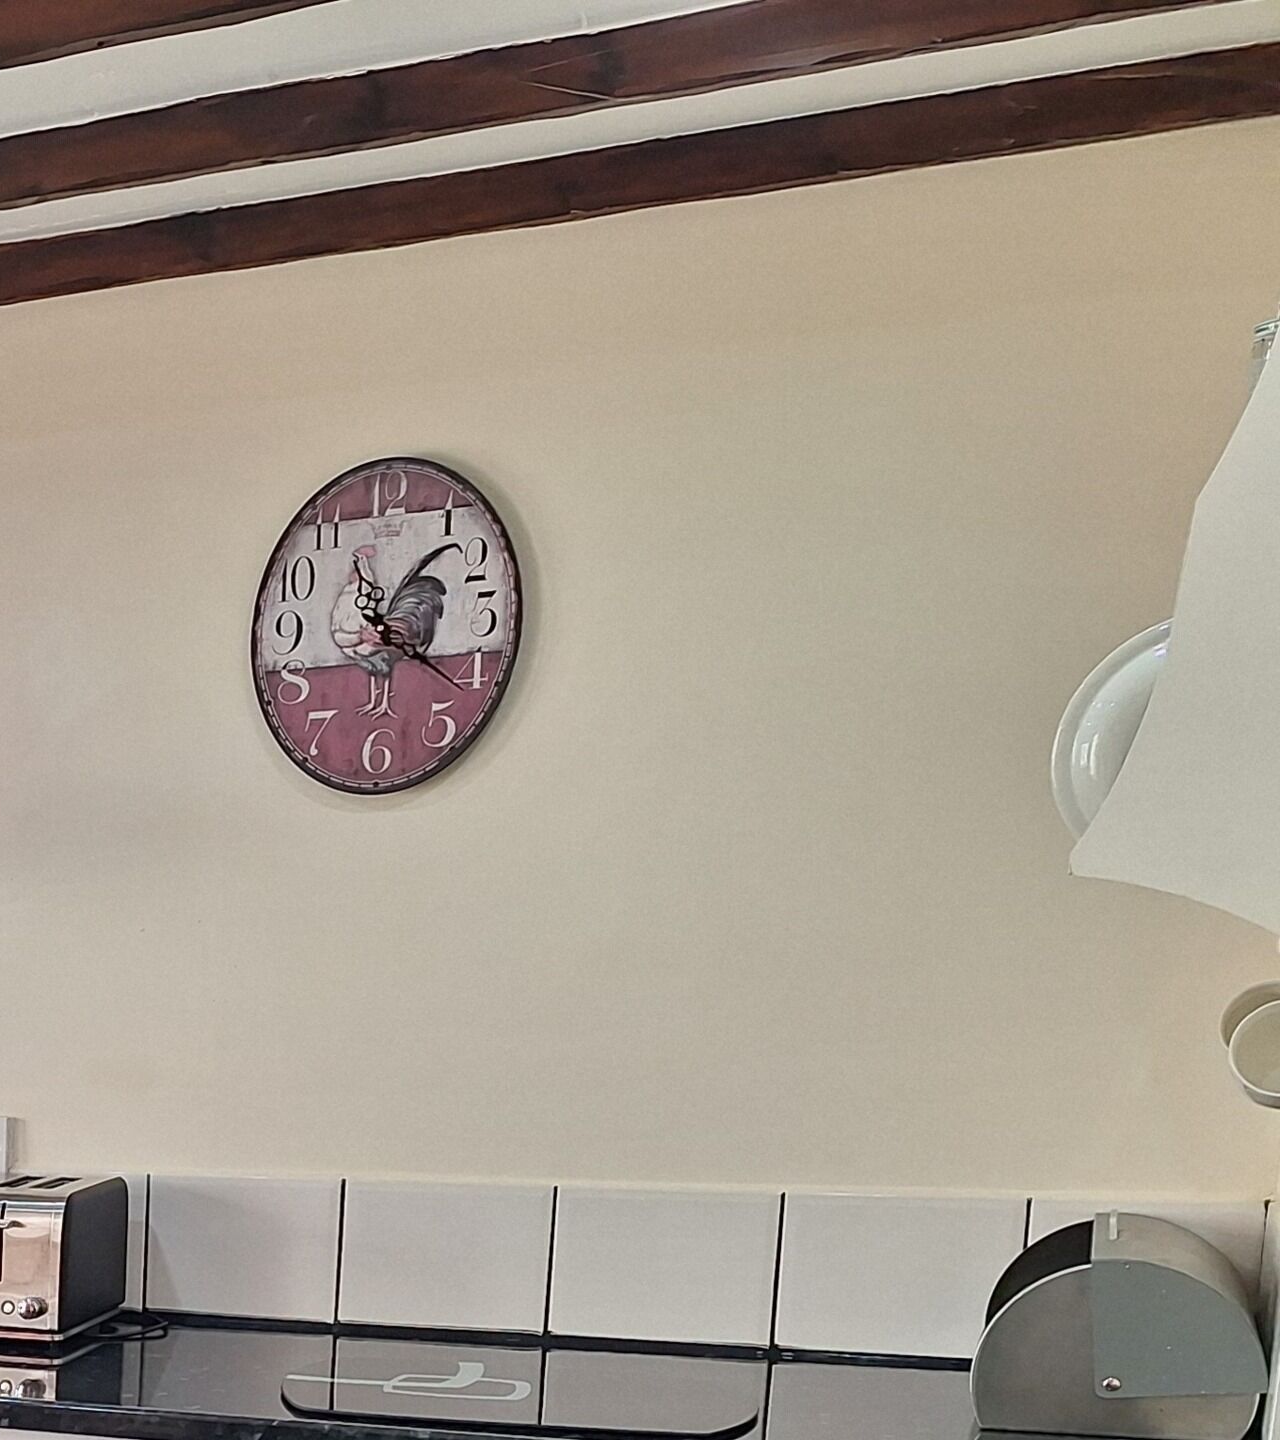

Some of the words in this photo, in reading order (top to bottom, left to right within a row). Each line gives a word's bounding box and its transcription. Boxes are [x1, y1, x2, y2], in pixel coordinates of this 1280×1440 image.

[373, 471, 407, 517] 12
[440, 489, 455, 537] 1
[313, 504, 341, 551] 11
[278, 555, 315, 603] 10
[464, 537, 488, 584] 2
[272, 610, 304, 655] 9
[277, 659, 310, 705] 8
[453, 645, 488, 689] 4
[304, 709, 338, 756] 7
[421, 700, 456, 748] 5
[362, 728, 396, 774] 6
